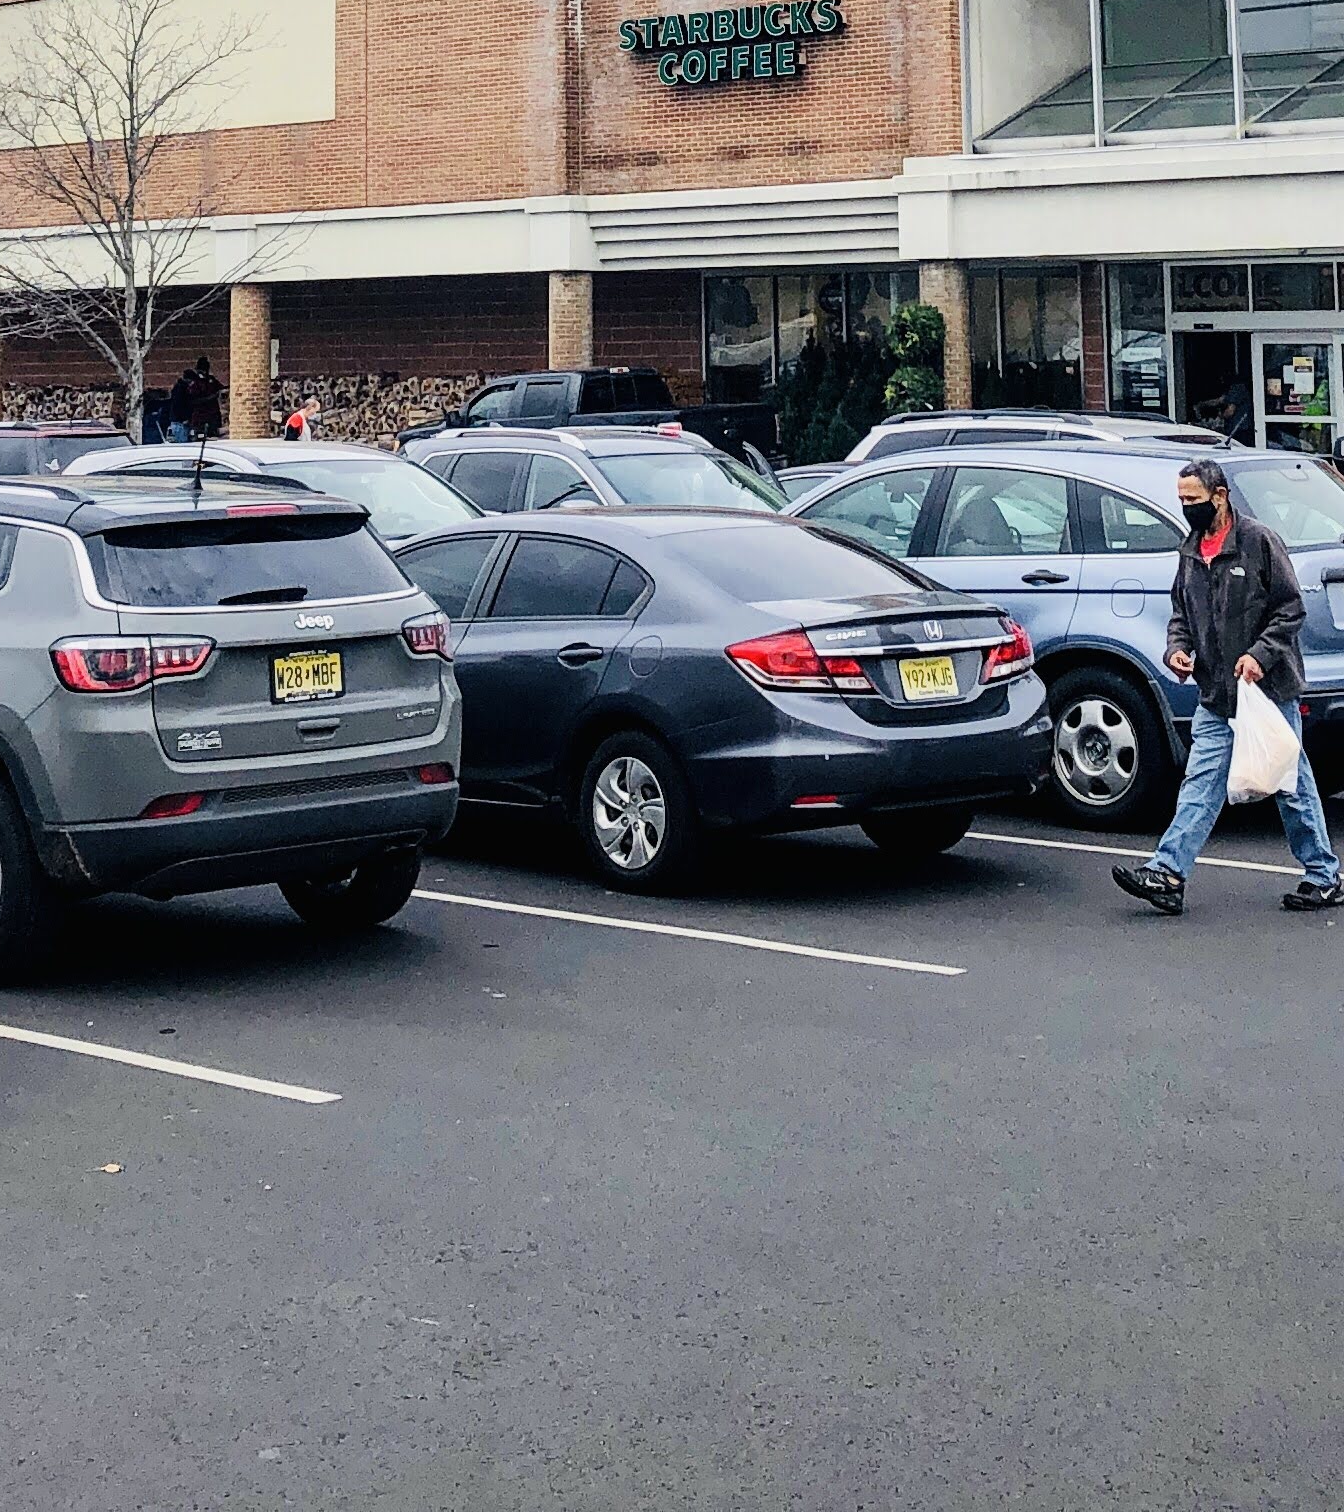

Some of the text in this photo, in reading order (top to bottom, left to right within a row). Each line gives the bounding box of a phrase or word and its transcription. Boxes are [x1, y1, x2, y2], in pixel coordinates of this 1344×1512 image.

[658, 41, 796, 86] COFFEE
[294, 612, 335, 630] Jeep
[825, 629, 867, 641] CIVIC
